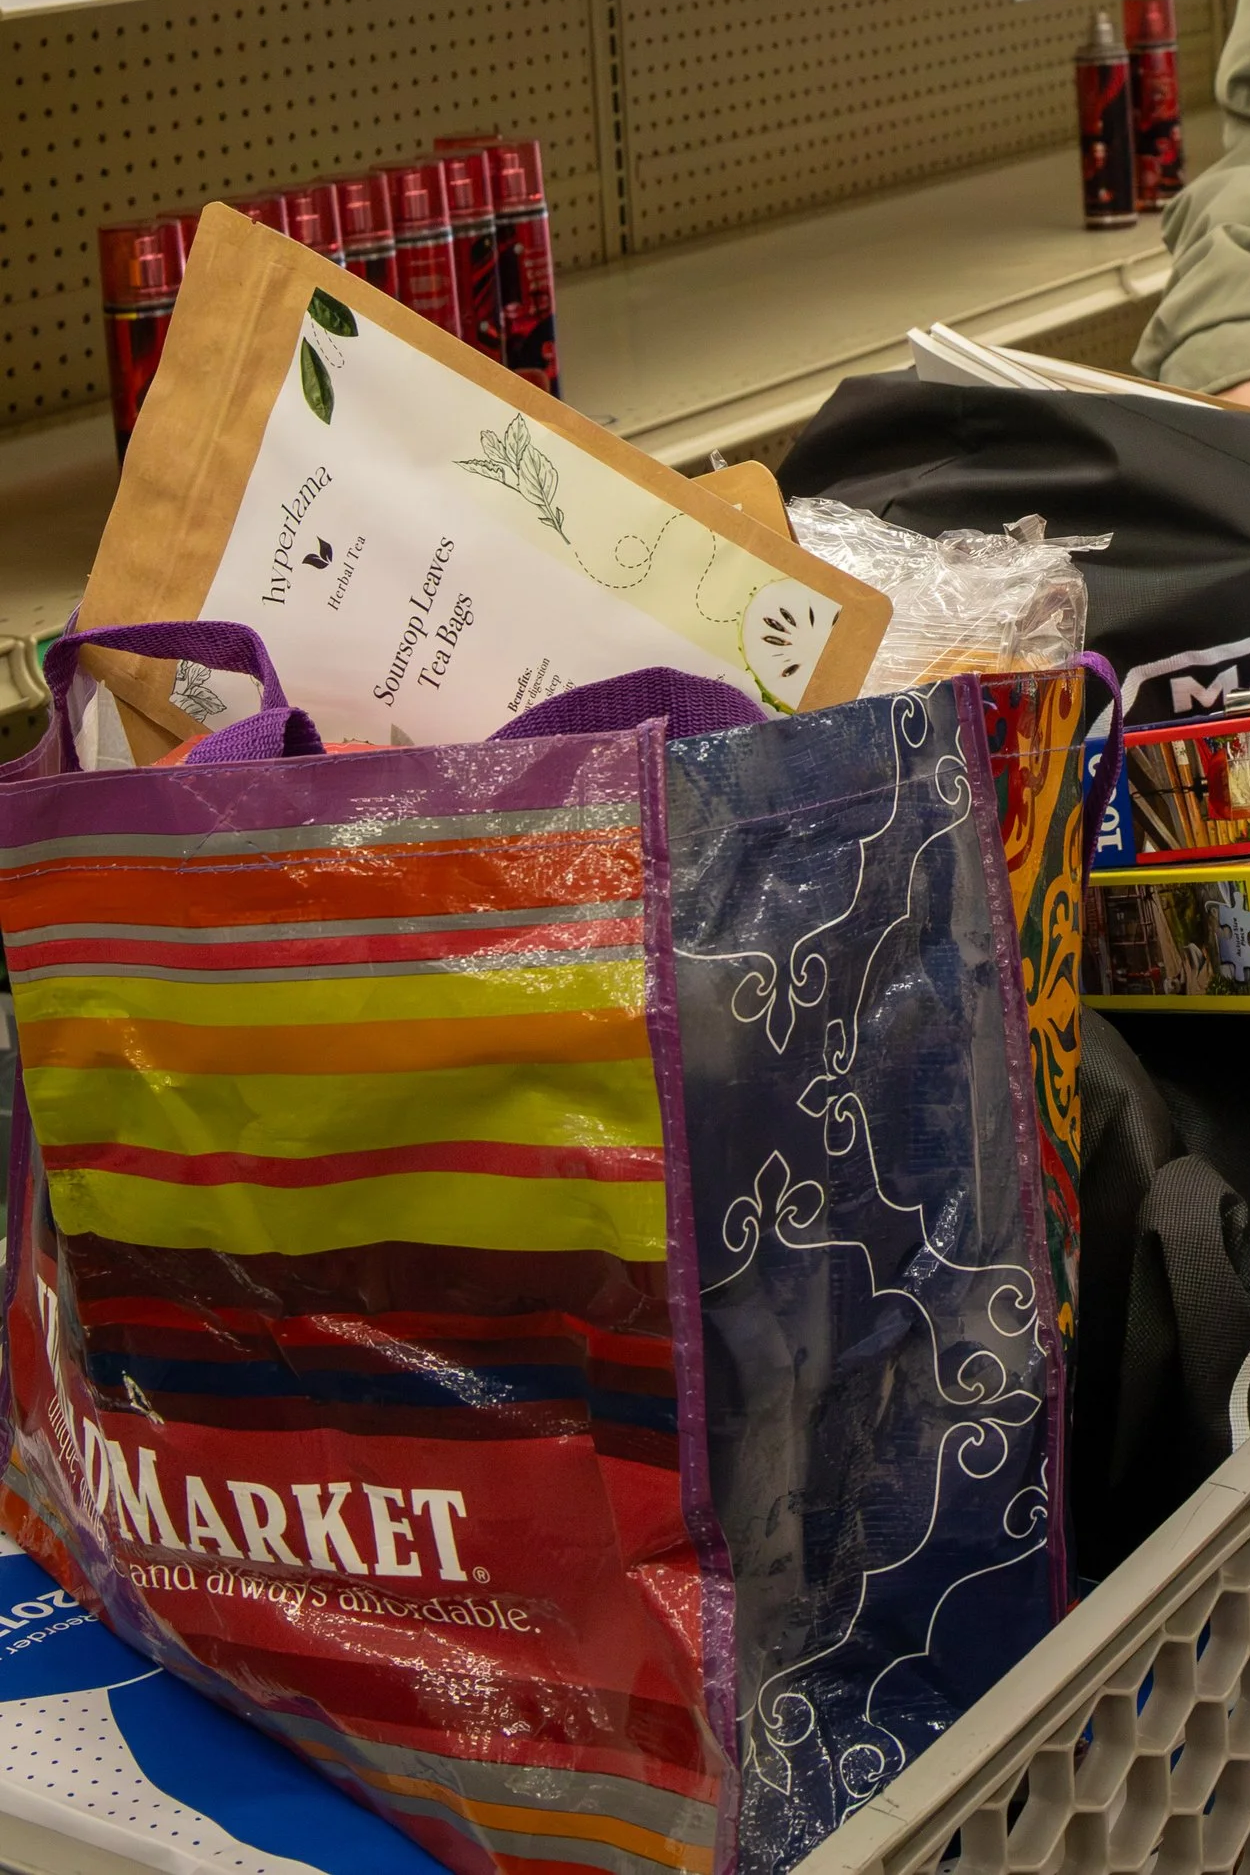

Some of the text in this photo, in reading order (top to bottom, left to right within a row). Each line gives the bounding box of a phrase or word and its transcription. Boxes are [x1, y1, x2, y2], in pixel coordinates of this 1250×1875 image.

[262, 466, 333, 605] hyperlama
[327, 535, 366, 611] Herbal Tea
[373, 536, 455, 707] Soursop Leaves
[417, 593, 474, 690] Tea Bags
[507, 667, 534, 713] Benefits:
[531, 657, 551, 703] digestion
[545, 674, 562, 700] sleep
[103, 1439, 469, 1582] MARKET
[128, 1560, 543, 1634] and always affordable.
